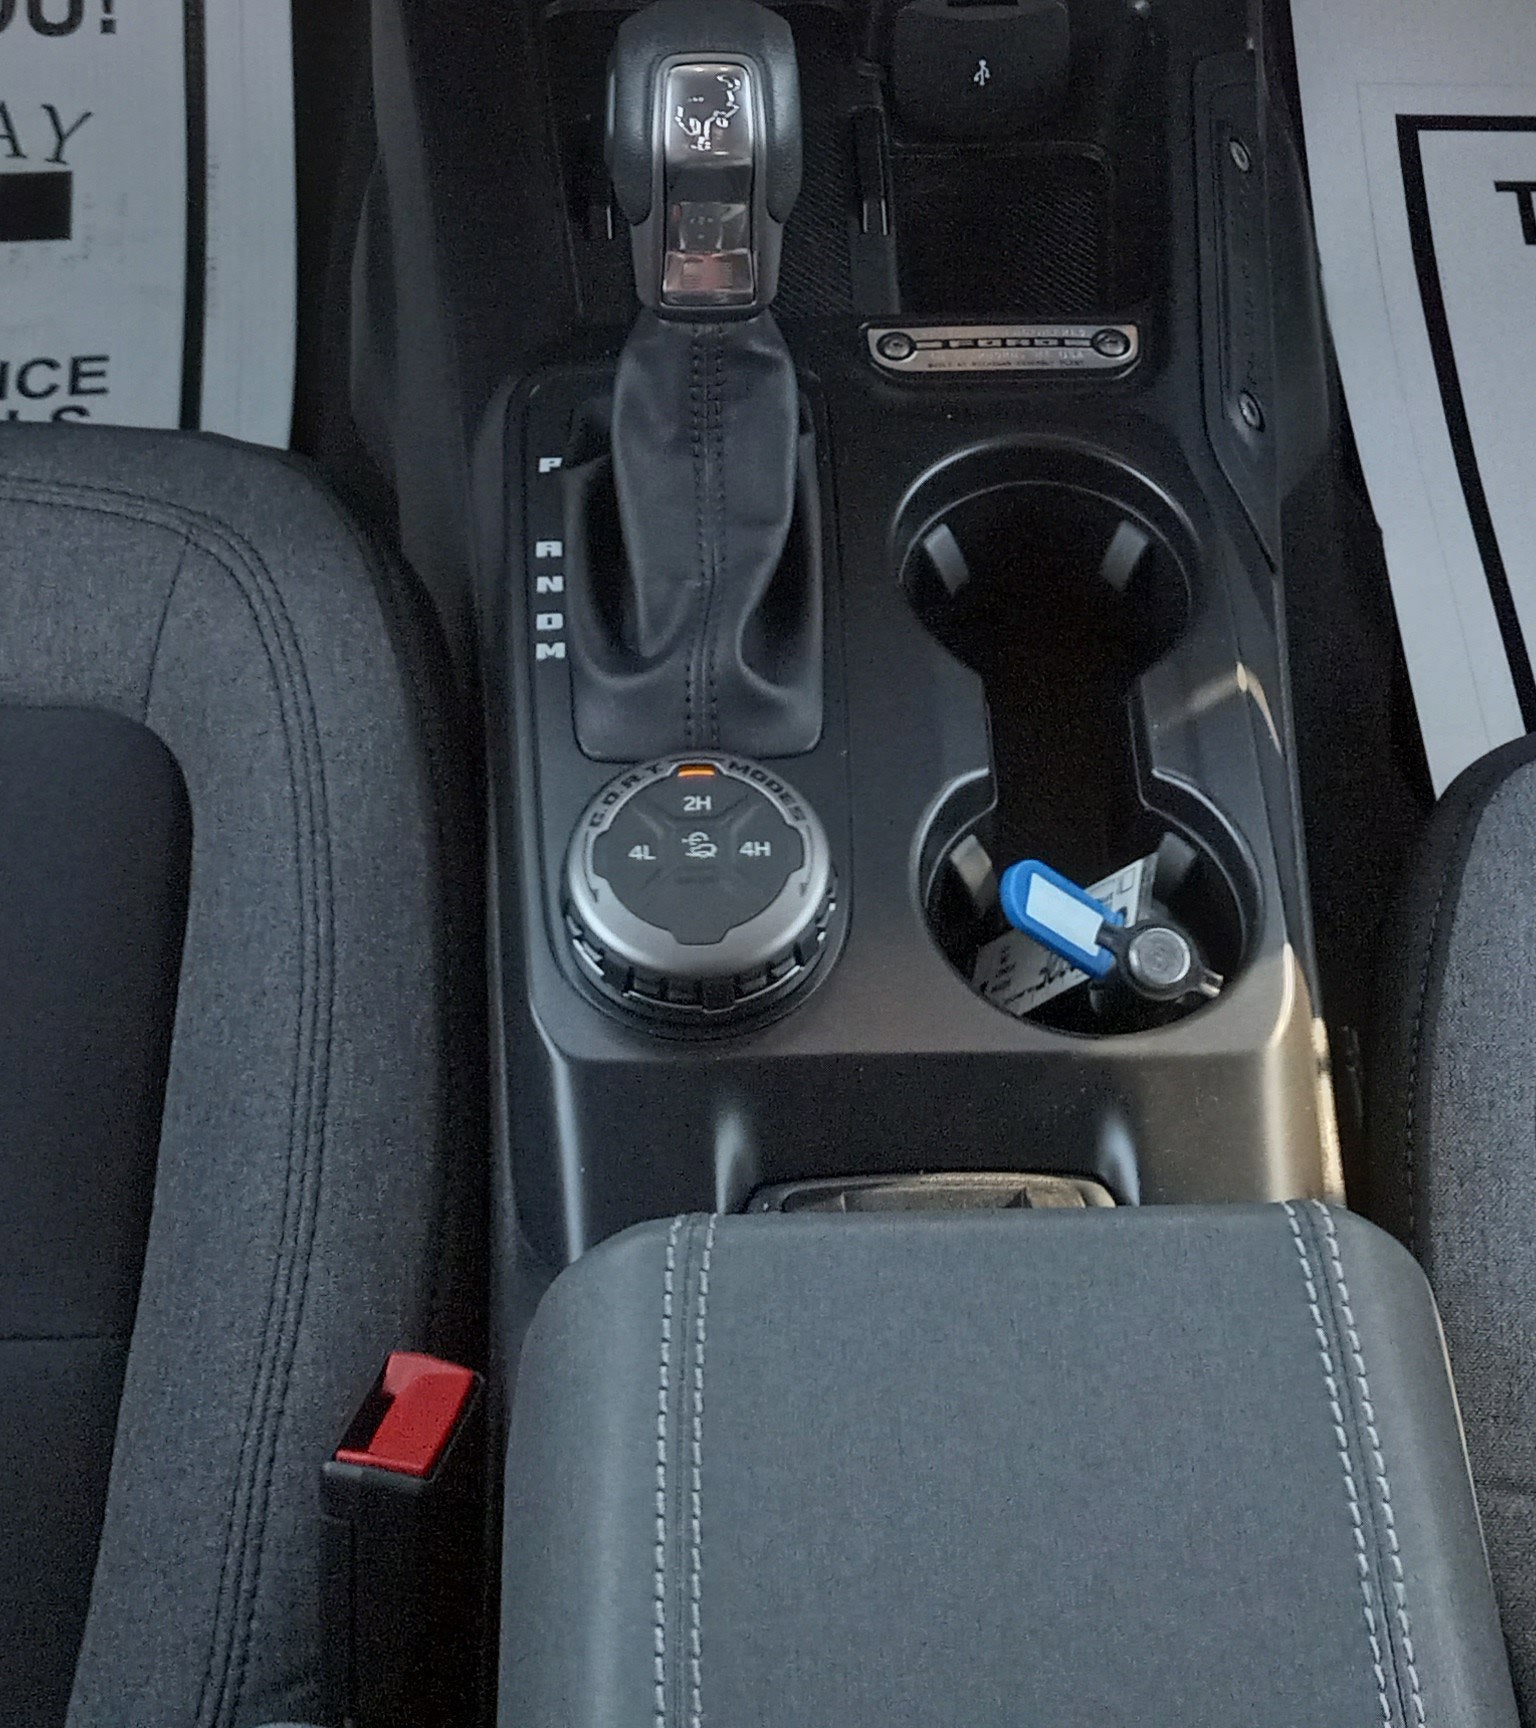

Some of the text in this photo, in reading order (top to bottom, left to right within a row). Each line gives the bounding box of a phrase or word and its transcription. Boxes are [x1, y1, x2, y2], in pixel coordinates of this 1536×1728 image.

[539, 457, 562, 472] P
[535, 540, 563, 558] R
[536, 576, 563, 593] N
[536, 613, 563, 630] D
[535, 642, 565, 660] M
[729, 760, 811, 823] MODES
[683, 795, 712, 812] 2H
[628, 845, 657, 861] 4L
[739, 841, 771, 857] 4H
